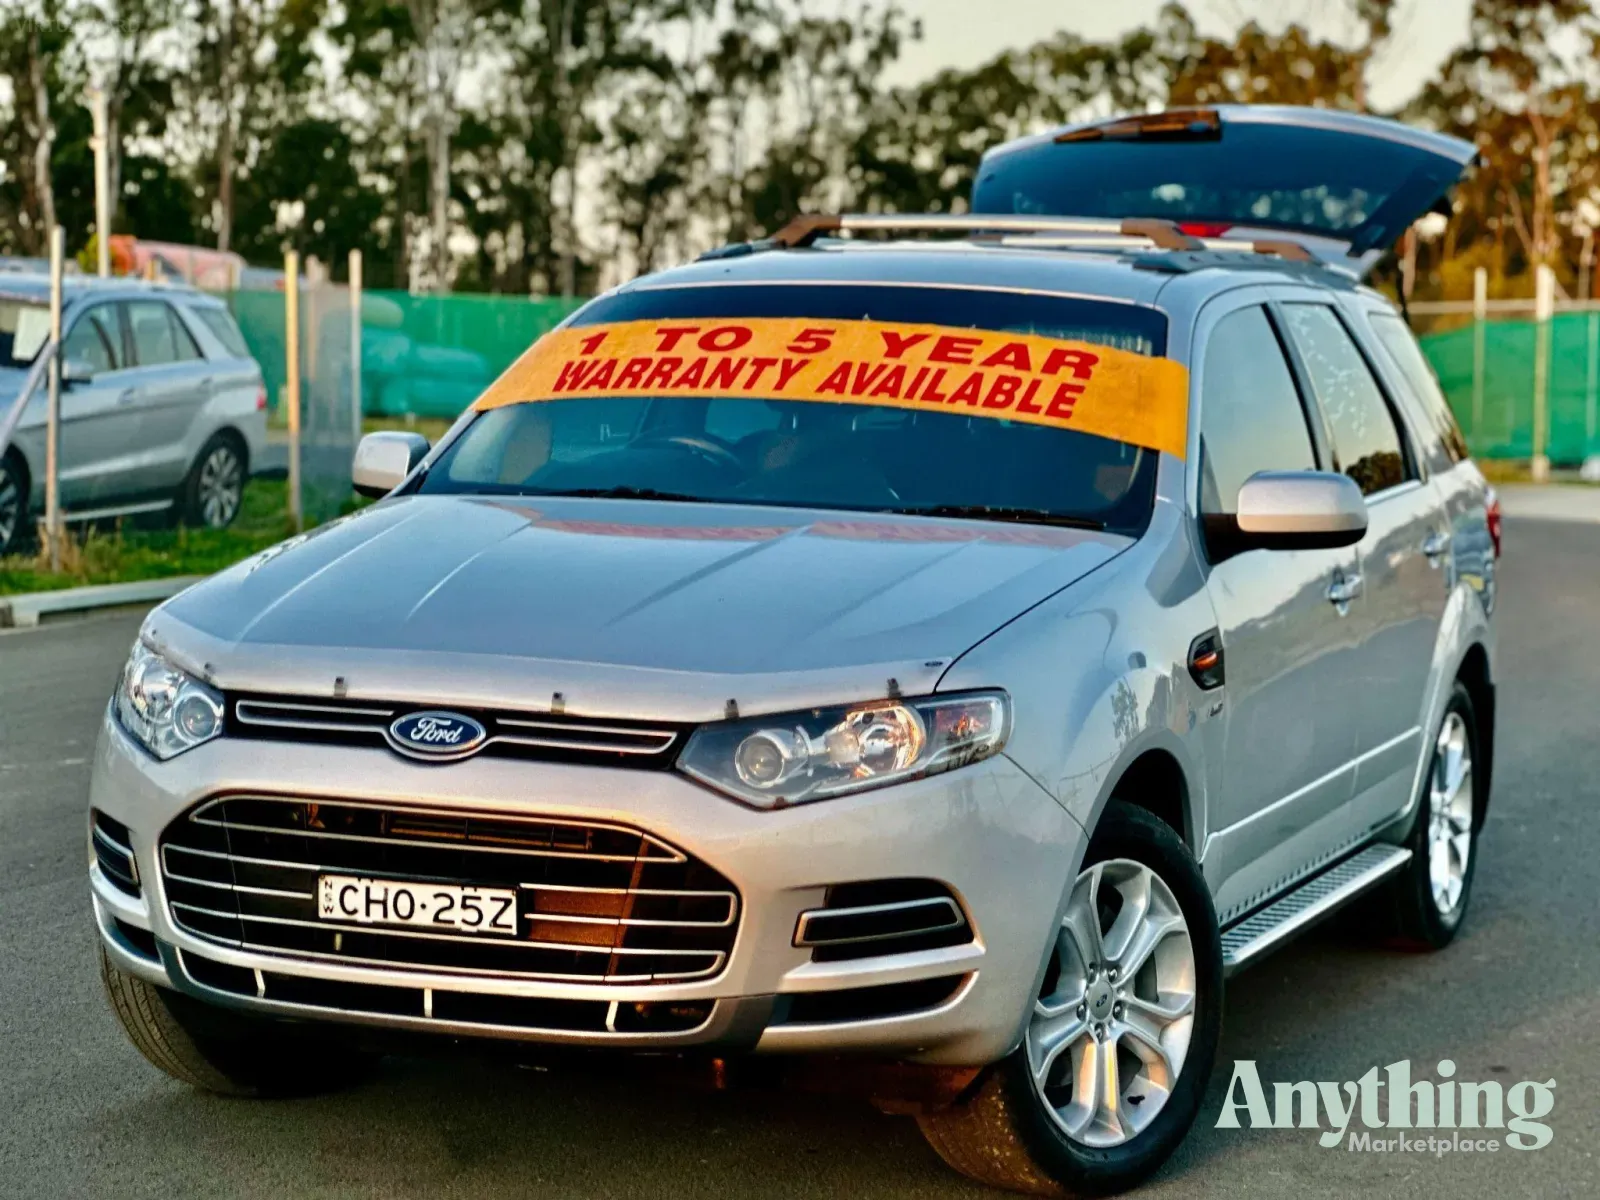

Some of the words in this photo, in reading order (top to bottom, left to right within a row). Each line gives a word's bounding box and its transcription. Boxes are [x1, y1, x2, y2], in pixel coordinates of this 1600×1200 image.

[580, 332, 609, 355] 1
[655, 326, 753, 352] TO
[786, 328, 836, 354] 5
[880, 331, 1100, 381] YEAR
[552, 357, 811, 393] WARRANTY
[815, 361, 1086, 420] AVAILABLE
[410, 717, 464, 743] Ford
